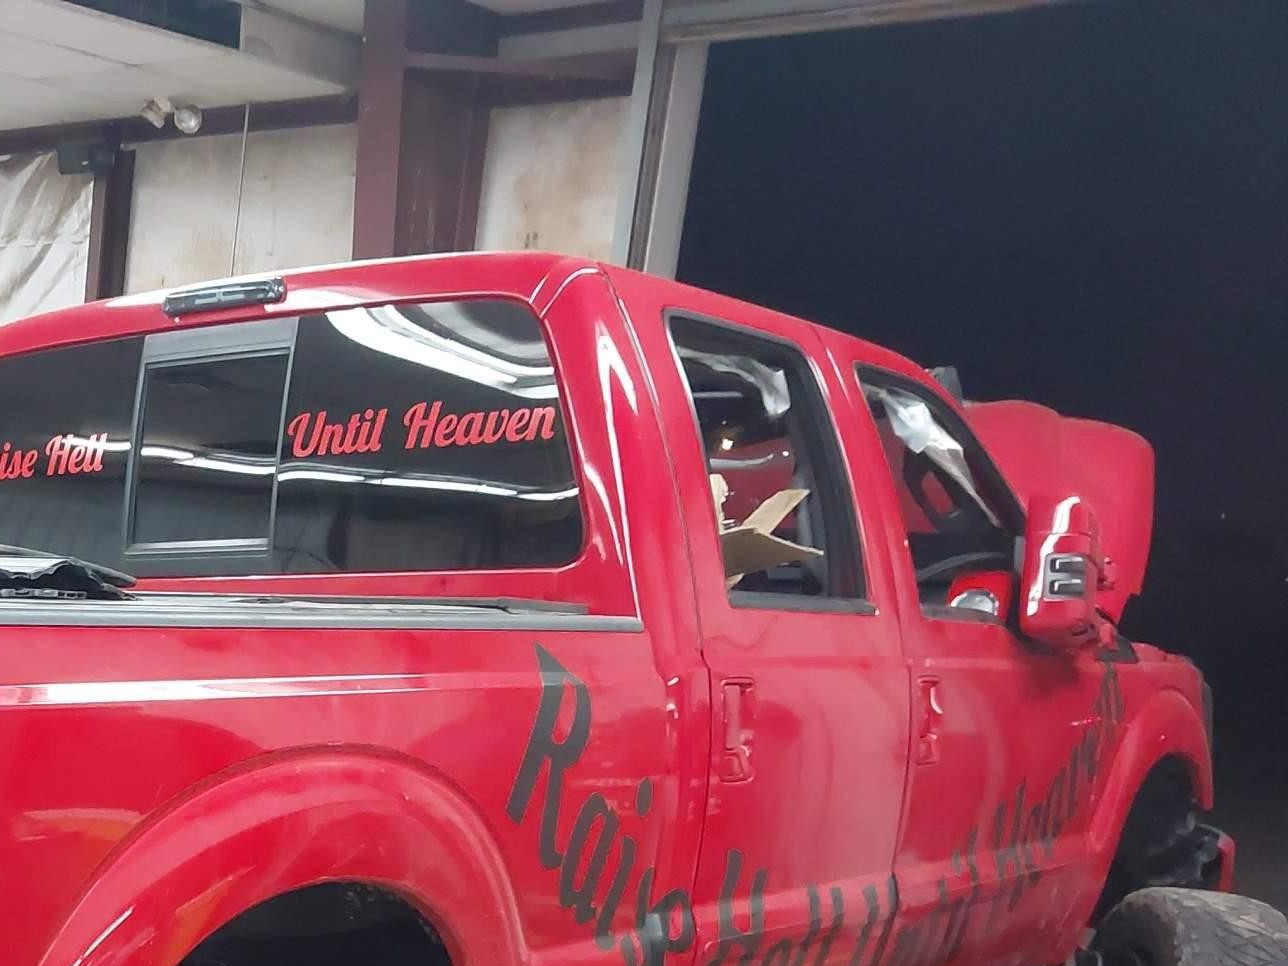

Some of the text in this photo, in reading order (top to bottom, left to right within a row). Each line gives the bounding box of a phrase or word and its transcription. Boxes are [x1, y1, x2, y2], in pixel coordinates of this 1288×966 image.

[45, 432, 108, 476] Hell
[287, 408, 388, 458] Until
[403, 401, 556, 449] Heaven
